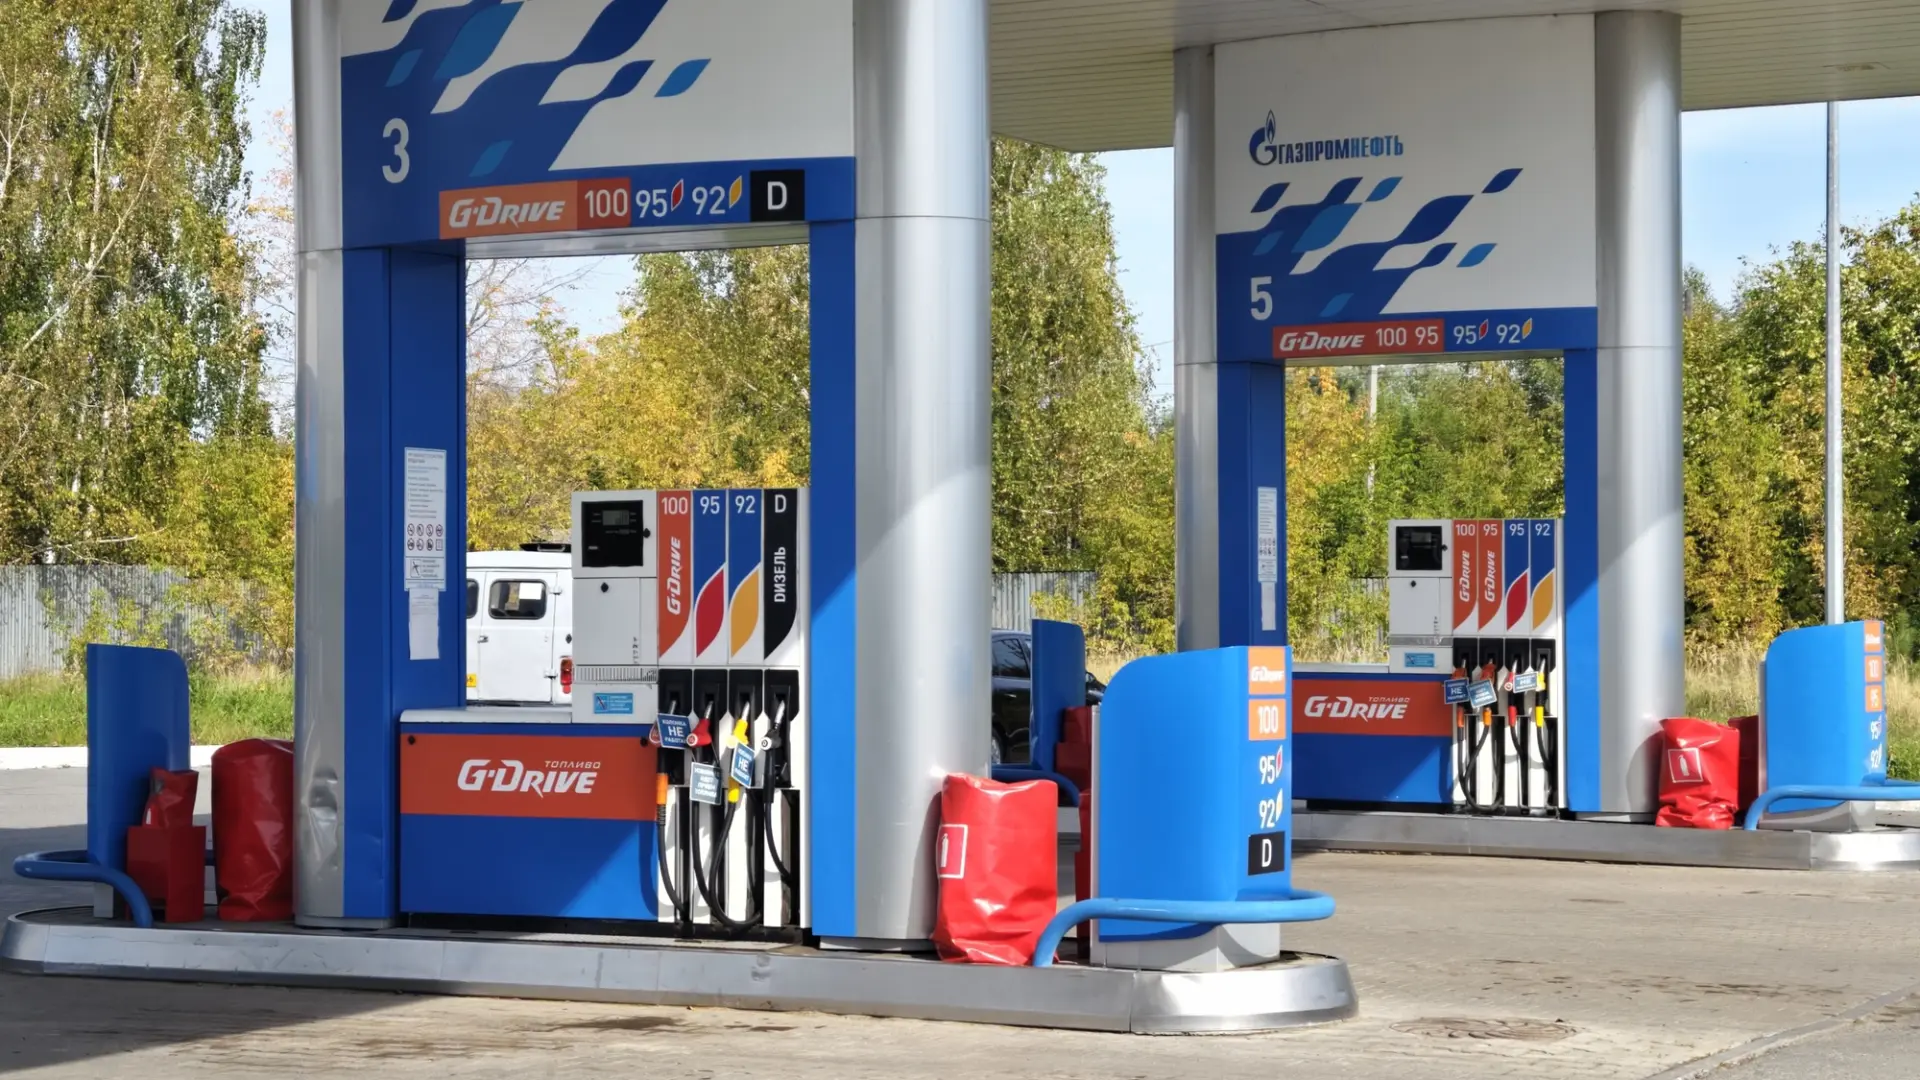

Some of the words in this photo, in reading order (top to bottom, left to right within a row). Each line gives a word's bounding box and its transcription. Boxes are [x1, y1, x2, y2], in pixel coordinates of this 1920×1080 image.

[382, 118, 410, 183] 3
[1278, 134, 1404, 165] ГАЗПРОМНЕФТЬ
[584, 188, 629, 219] 100
[636, 188, 667, 218] 95
[692, 185, 726, 215] 92
[767, 181, 788, 210] D
[1250, 275, 1273, 321] 5
[1375, 327, 1407, 347] 100
[1415, 326, 1439, 345] 95
[1453, 325, 1478, 345] 95
[1496, 324, 1521, 344] 92
[661, 497, 689, 515] 100
[700, 496, 720, 514] 95
[735, 495, 756, 514] 92
[774, 494, 787, 513] D
[1456, 523, 1476, 536] 100
[1483, 523, 1498, 536] 95
[1509, 523, 1525, 536] 95
[1535, 523, 1551, 536] 92
[1257, 705, 1279, 734] 100
[668, 726, 684, 737] НЕ
[544, 760, 601, 769] ТОПЛИВО
[738, 760, 749, 772] НЕ
[1259, 755, 1276, 784] 95
[1259, 799, 1276, 829] 92
[1261, 838, 1273, 868] D
